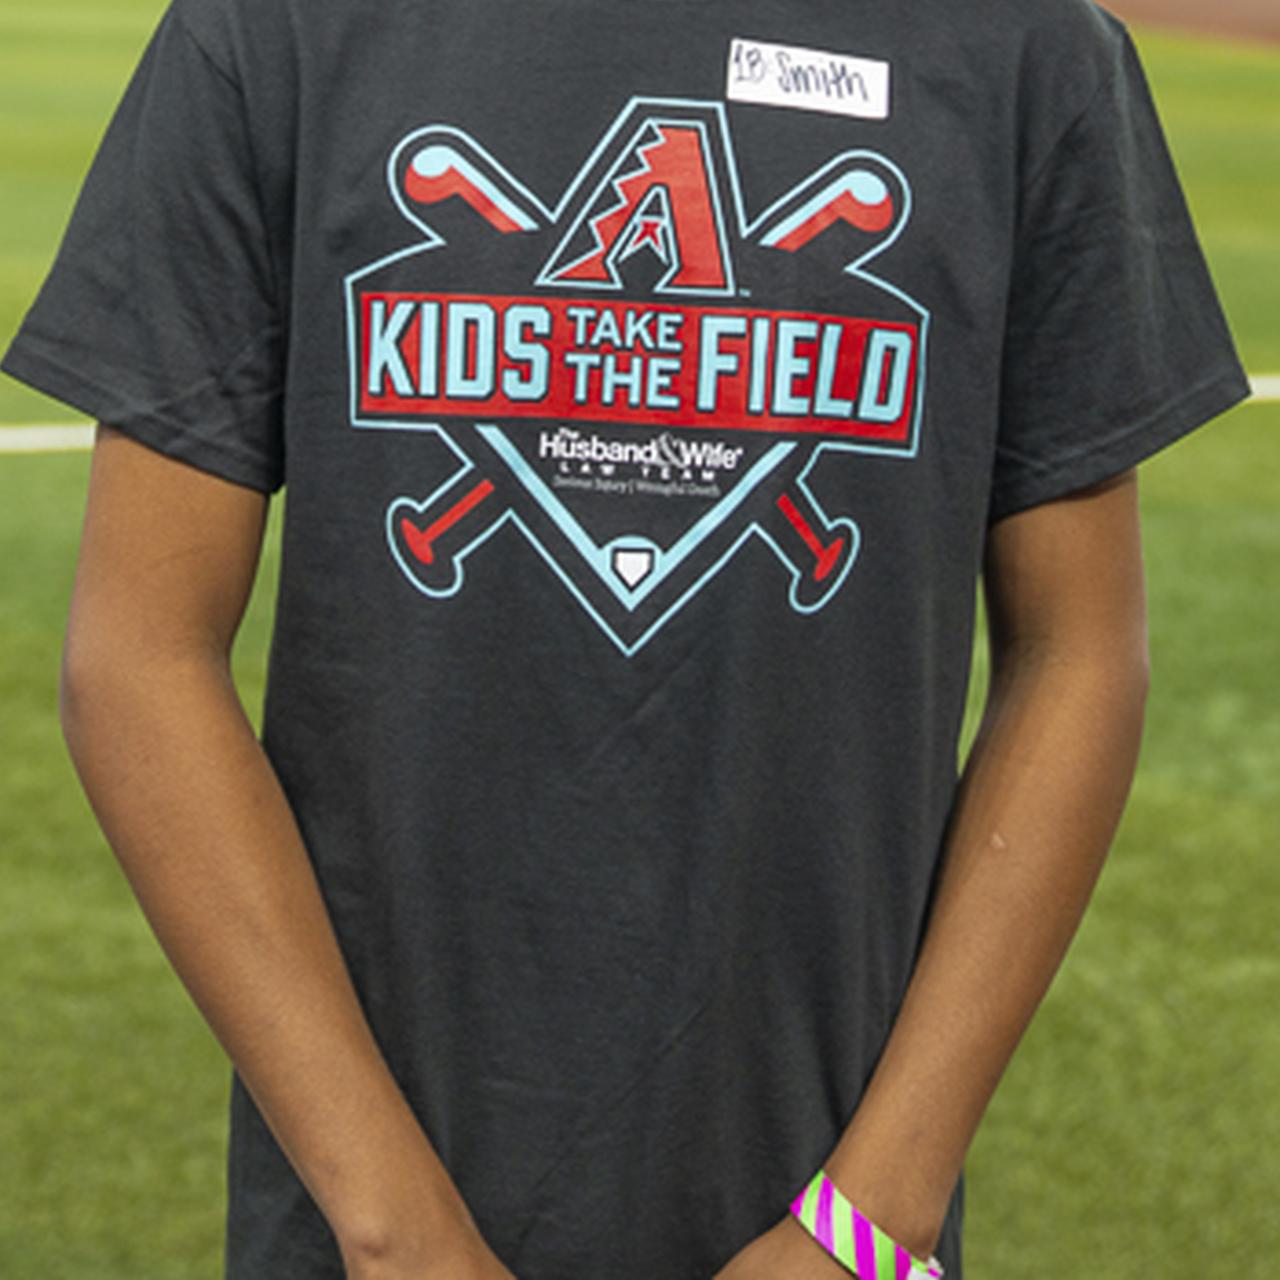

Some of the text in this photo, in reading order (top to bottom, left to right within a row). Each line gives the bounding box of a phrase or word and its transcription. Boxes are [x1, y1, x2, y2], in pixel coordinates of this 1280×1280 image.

[775, 51, 868, 101] Smith
[366, 298, 552, 402] KIDS
[566, 307, 684, 351] TAKE
[564, 352, 681, 409] THE
[696, 315, 914, 423] FIELD
